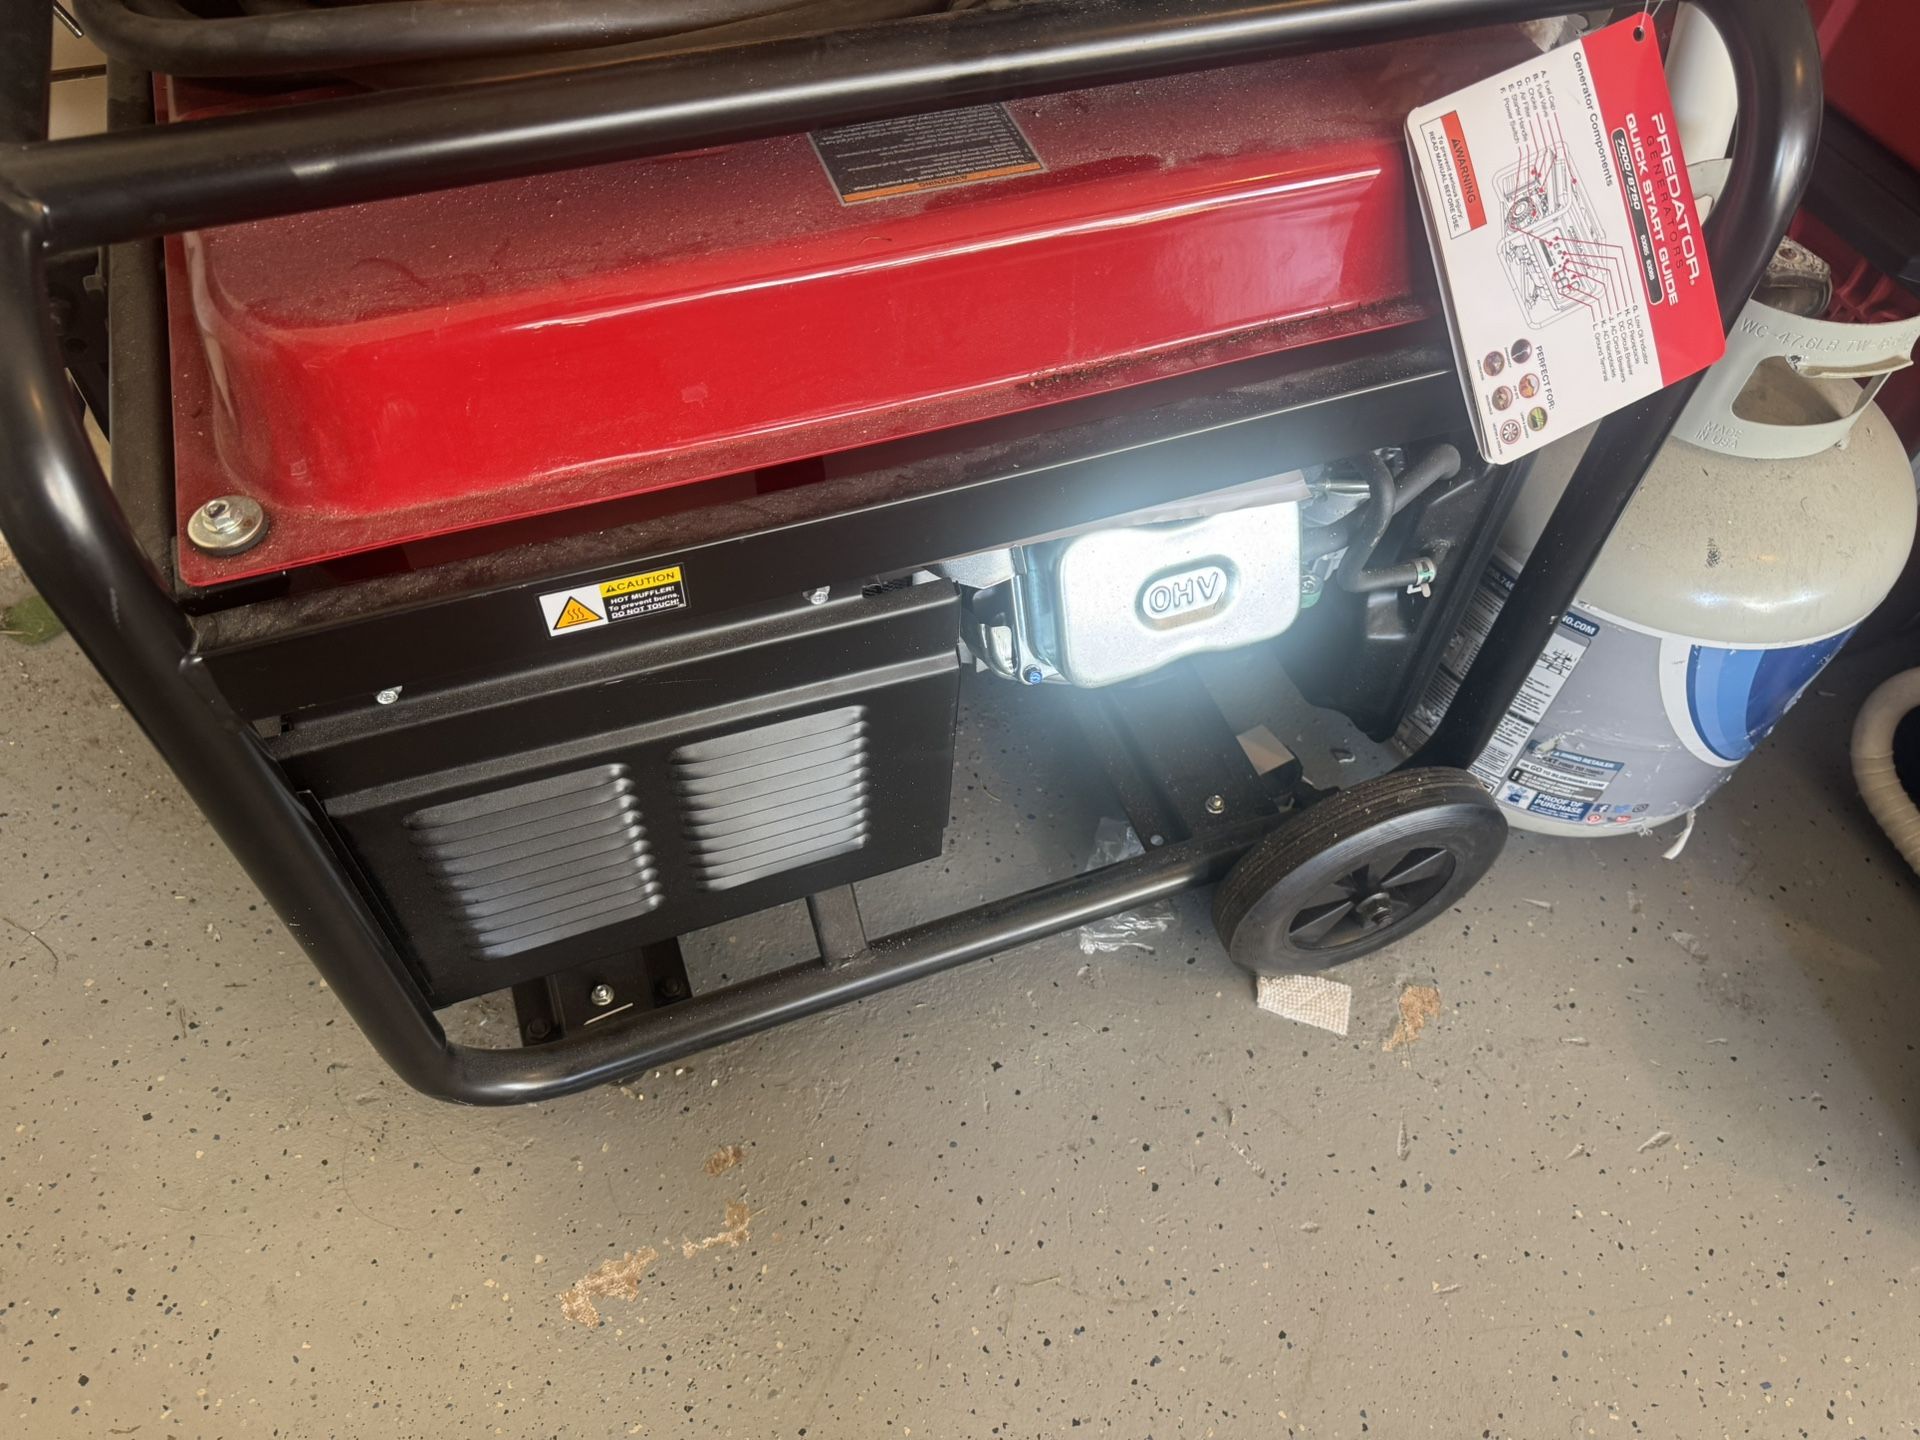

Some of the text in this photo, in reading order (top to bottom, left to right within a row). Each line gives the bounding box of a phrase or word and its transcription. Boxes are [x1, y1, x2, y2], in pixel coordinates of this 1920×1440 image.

[1535, 83, 1544, 98] Fuel
[1543, 80, 1552, 94] Fuel
[1527, 87, 1538, 110] Choke
[1539, 99, 1549, 117] Valve
[1546, 95, 1556, 110] Cap
[1511, 93, 1522, 116] Starter
[1517, 117, 1528, 141] Handle
[1522, 101, 1531, 118] Filter
[1572, 51, 1613, 186] Generator Components
[1503, 97, 1513, 119] Power
[1509, 119, 1520, 143] Switch
[1437, 135, 1444, 145] To
[1439, 145, 1451, 172] prevent
[1428, 130, 1459, 230] READ MANUAL BEFORE USE.
[1454, 146, 1476, 203] WARNING
[1447, 172, 1458, 197] serious
[1624, 113, 1679, 305] QUICK START GUIDE
[1645, 135, 1684, 269] GENERATORS
[1609, 324, 1617, 335] AC
[1617, 320, 1625, 331] DC
[1626, 318, 1633, 329] DC
[1594, 332, 1603, 356] Ground
[1601, 329, 1609, 340] AC
[1620, 332, 1629, 351] Circuit
[1633, 314, 1641, 328] Low
[1639, 339, 1649, 364] Indicator
[1612, 335, 1621, 355] Circuit
[1616, 356, 1626, 382] Breakers
[1625, 352, 1634, 375] Breaker
[1535, 345, 1555, 410] PERFECT FOR:
[1703, 421, 1743, 438] MADE
[1696, 430, 1738, 449] IN USA
[616, 572, 676, 592] CAUTION
[610, 585, 675, 604] HOT MUFFLER!
[1149, 571, 1218, 613] OHV
[608, 604, 619, 612] To
[620, 598, 652, 610] prevent
[611, 598, 680, 619] DO NOT TOUCH!
[1529, 764, 1542, 772] GO
[1581, 757, 1615, 768] RETAILER
[1534, 798, 1583, 814] PURCHASE
[1537, 793, 1569, 805] PROOF
